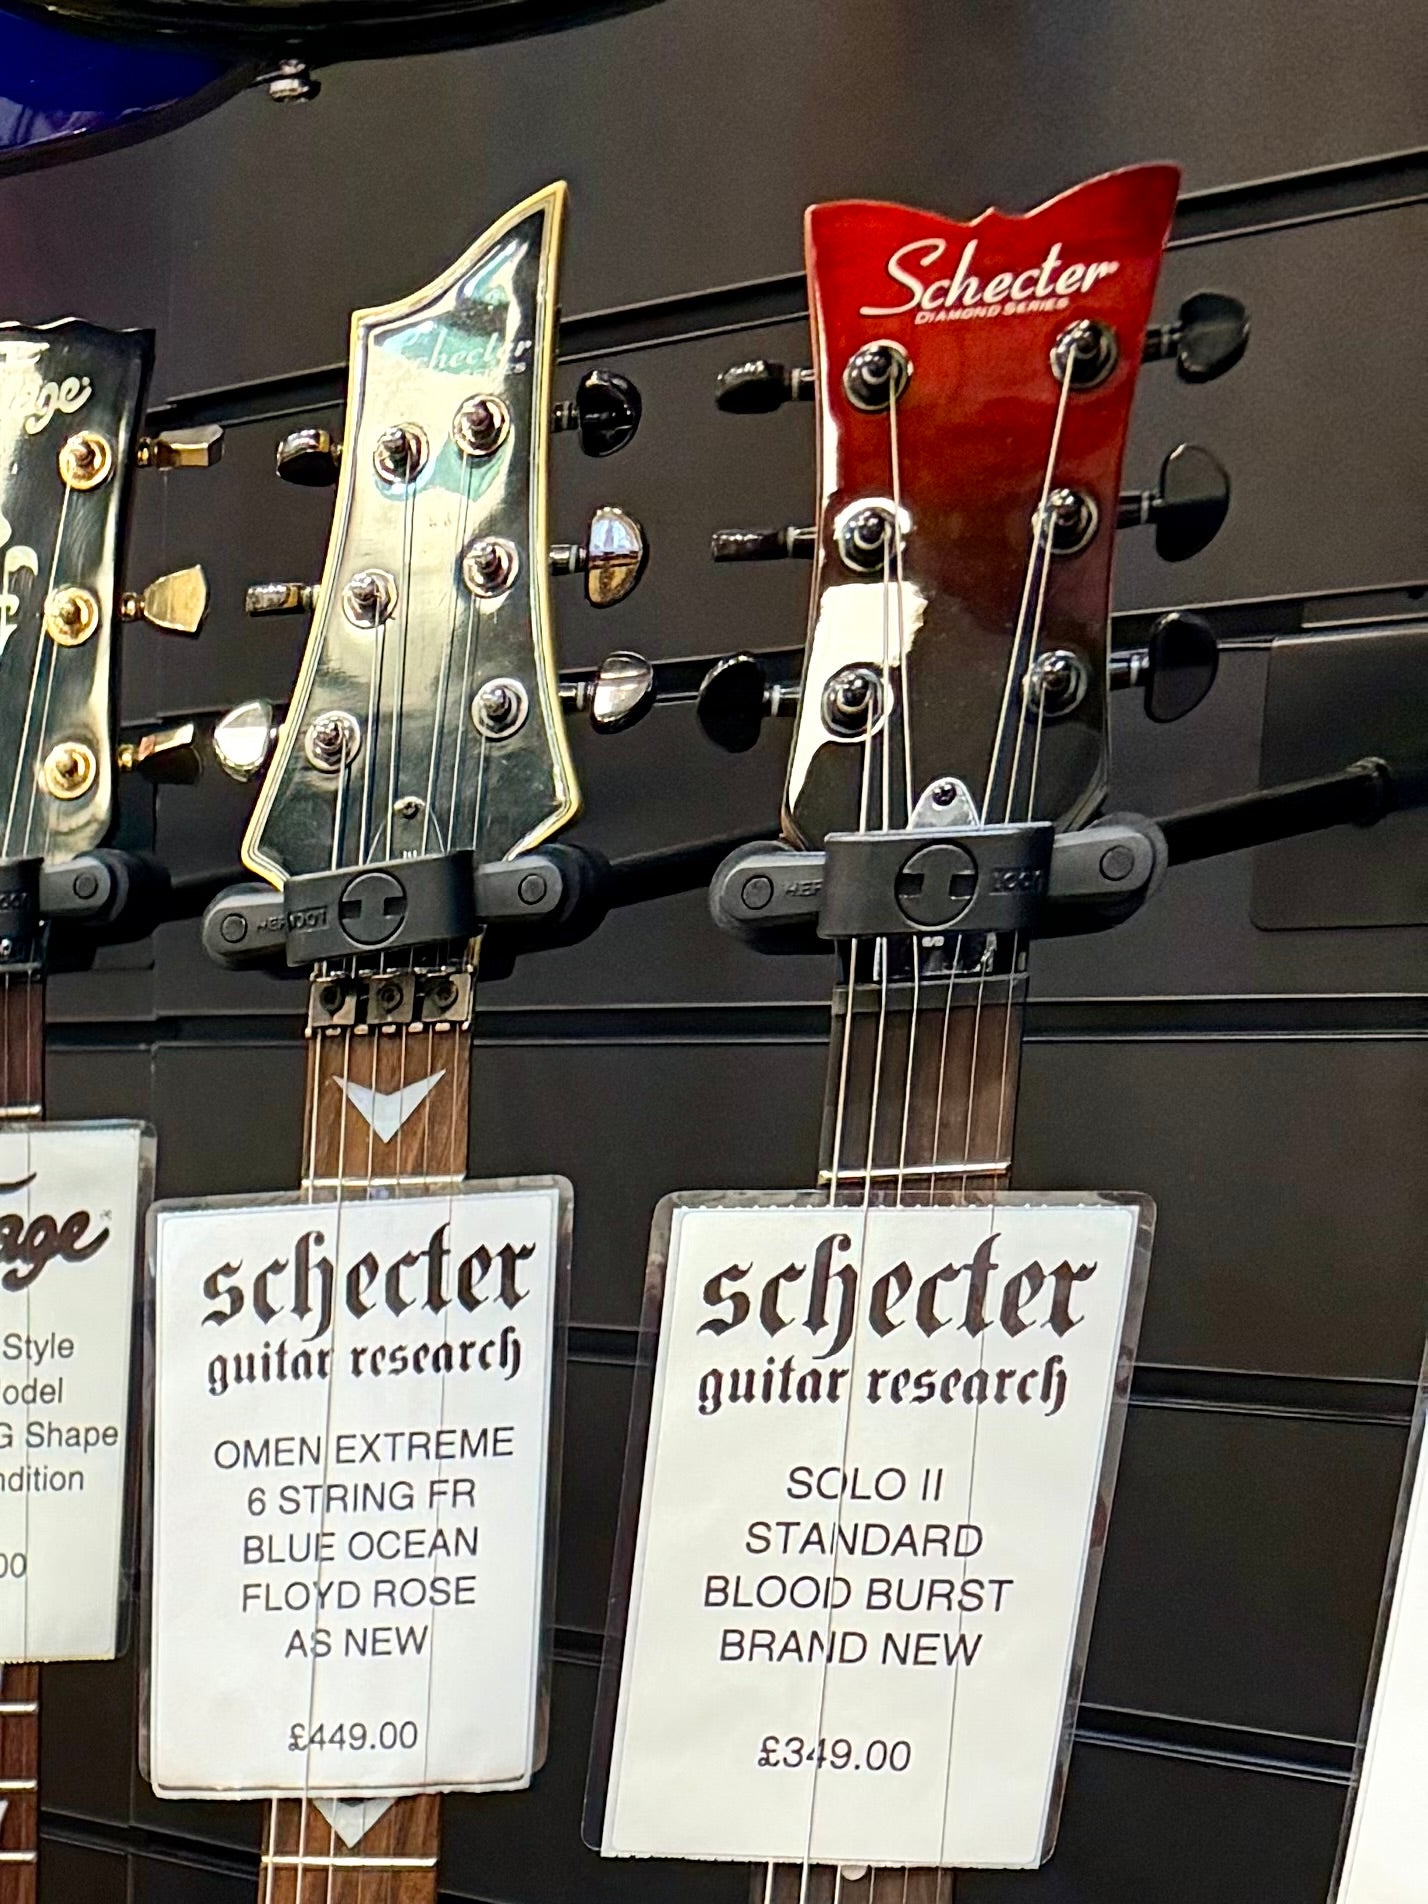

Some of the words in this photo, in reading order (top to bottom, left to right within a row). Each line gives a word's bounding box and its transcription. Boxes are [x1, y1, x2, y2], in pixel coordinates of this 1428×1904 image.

[860, 238, 1120, 316] Schecter
[915, 302, 1000, 324] DIAMOND
[1003, 298, 1070, 316] SERIES
[201, 1220, 538, 1344] schecter
[695, 1230, 1100, 1361] schecter
[2, 1332, 75, 1367] Style
[206, 1337, 336, 1397] guitar
[350, 1325, 524, 1382] research
[696, 1355, 850, 1418] guitar
[865, 1352, 1071, 1418] research
[25, 1421, 120, 1454] Shape
[213, 1435, 323, 1471] OMEN
[335, 1425, 516, 1465] EXTREME
[246, 1486, 268, 1518] 6
[278, 1480, 416, 1516] STRING
[428, 1478, 477, 1511] FR
[785, 1465, 907, 1503] SOLO
[921, 1468, 945, 1503] II
[241, 1532, 337, 1566] BLUE
[347, 1527, 479, 1562] OCEAN
[744, 1519, 985, 1560] STANDARD
[240, 1579, 362, 1613] FLOYD
[373, 1575, 478, 1609] ROSE
[703, 1574, 853, 1611] BLOOD
[864, 1576, 1016, 1614] BURST
[284, 1627, 333, 1660] AS
[344, 1624, 430, 1657] NEW
[718, 1628, 869, 1666] BRAND
[880, 1631, 985, 1667] NEW
[287, 1721, 419, 1754] £449.00
[757, 1735, 913, 1773] £349.00
